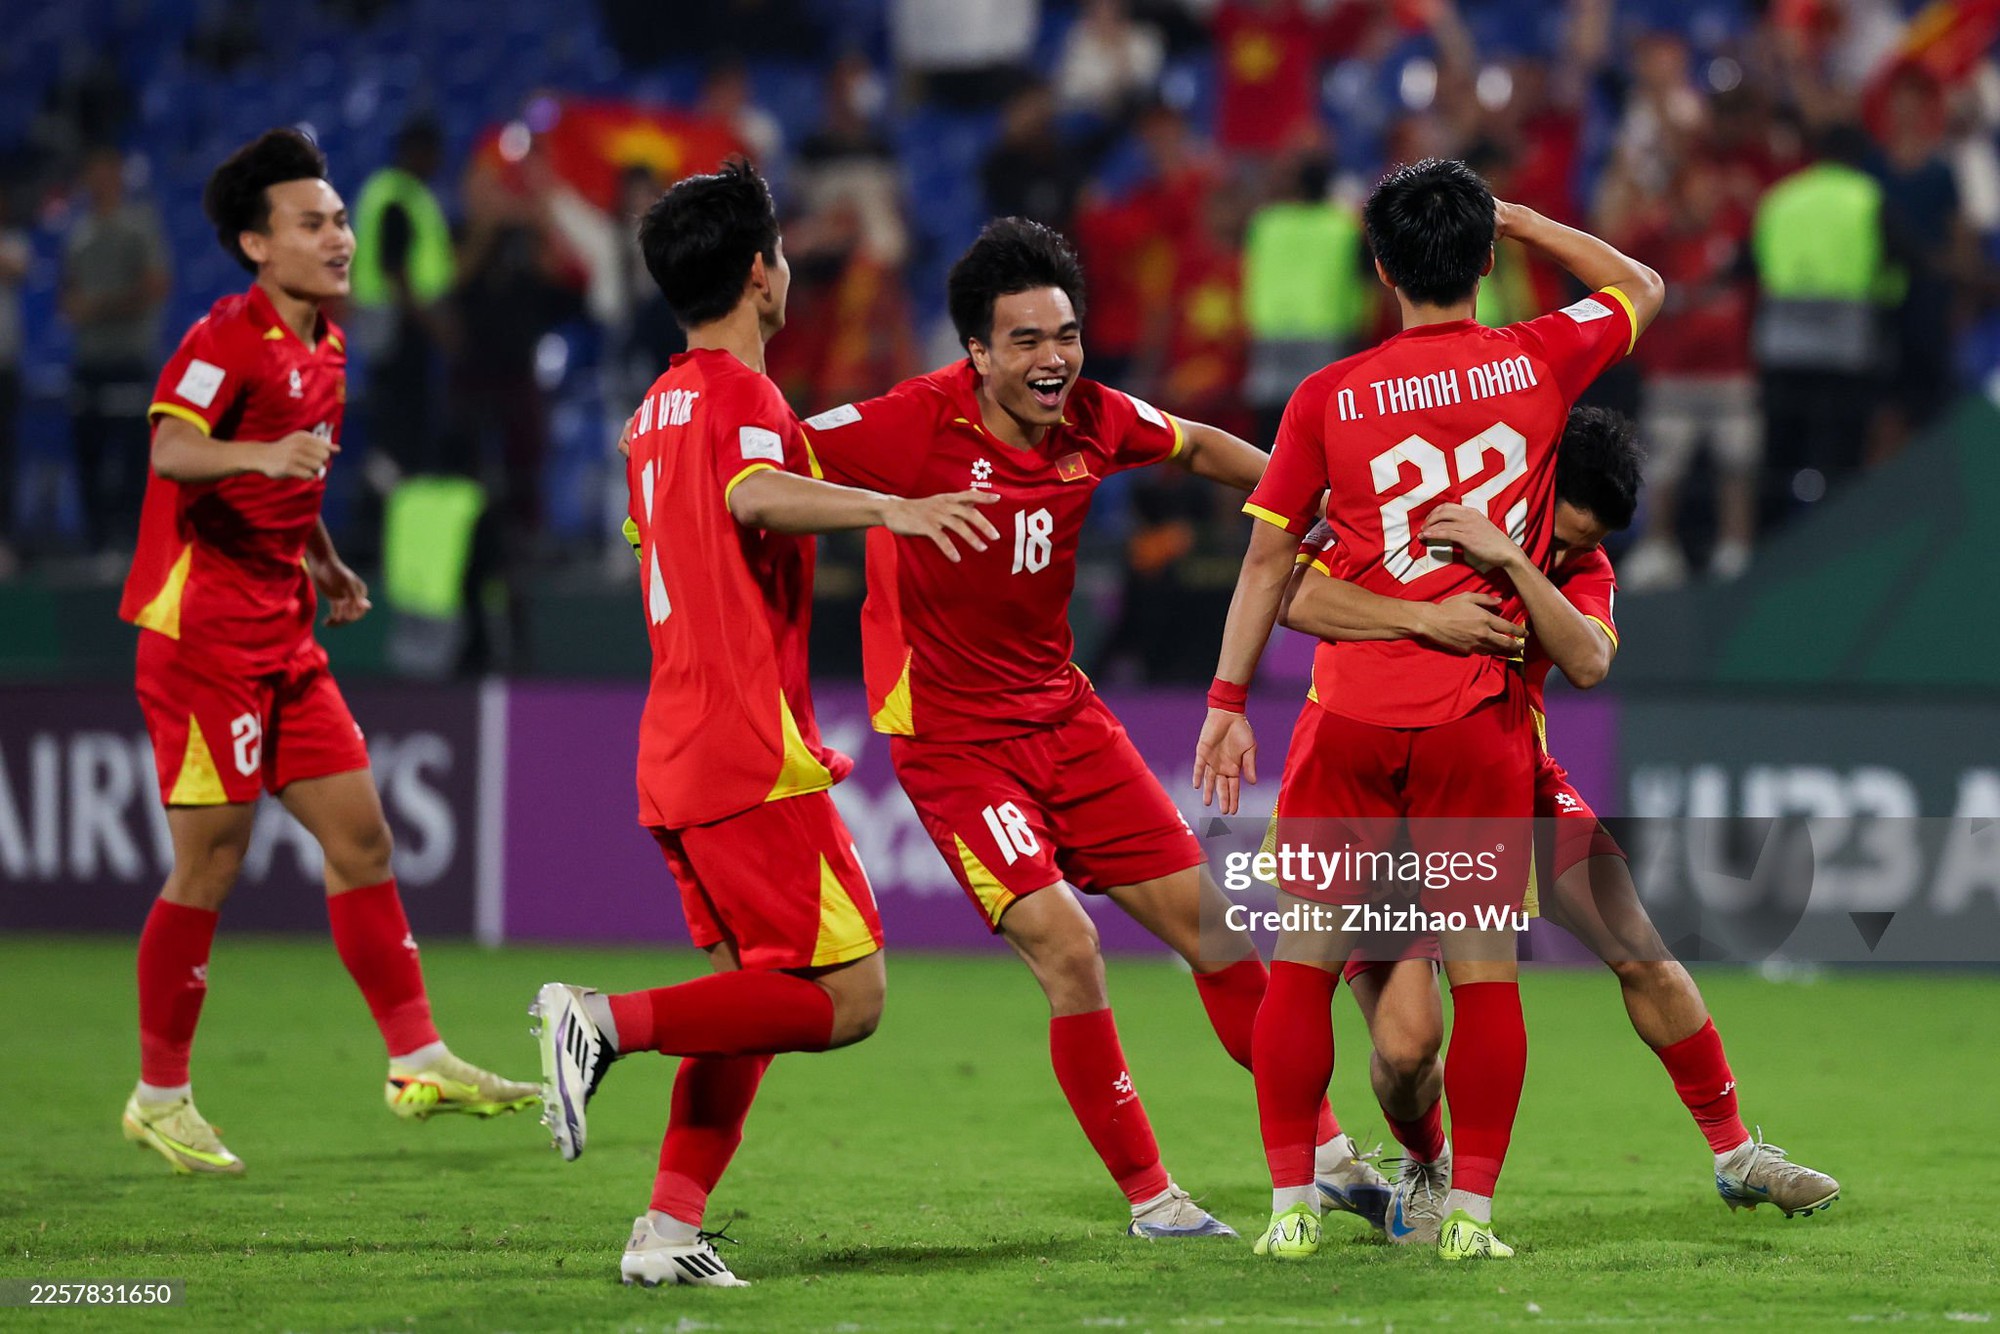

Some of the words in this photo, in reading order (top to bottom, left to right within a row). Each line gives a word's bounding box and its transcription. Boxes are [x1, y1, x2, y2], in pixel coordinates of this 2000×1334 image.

[1337, 387, 1364, 421] N.
[1370, 369, 1461, 416] THANH
[1467, 354, 1538, 401] NHAN
[1369, 421, 1528, 585] 22
[1012, 507, 1054, 575] 18
[981, 800, 1041, 867] 18
